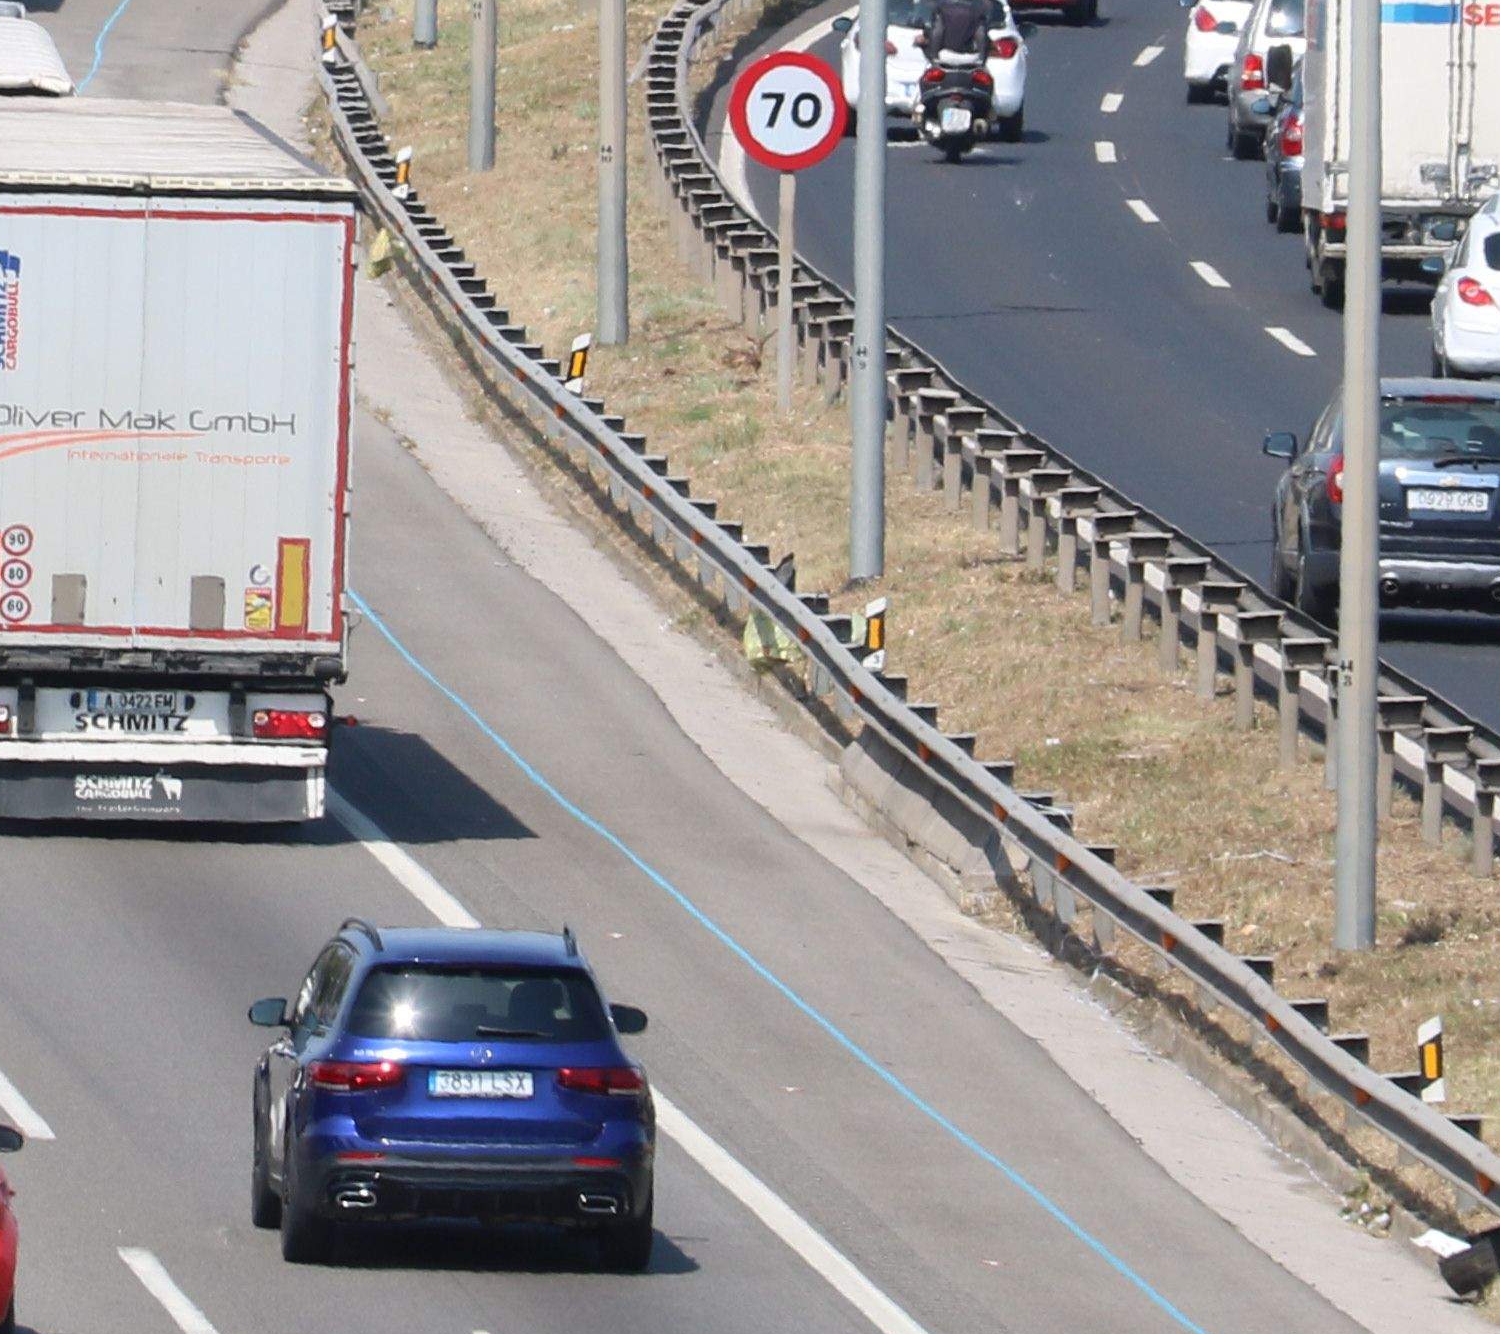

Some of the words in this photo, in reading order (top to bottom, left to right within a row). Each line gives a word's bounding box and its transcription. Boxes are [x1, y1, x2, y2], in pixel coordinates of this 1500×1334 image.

[758, 90, 823, 131] 70
[6, 280, 20, 371] CARGOBULL
[98, 408, 177, 432] Mak
[188, 409, 298, 436] GmbH
[67, 449, 189, 463] Internationale
[195, 451, 292, 466] Transporte
[8, 533, 26, 545] 90
[7, 568, 24, 580] 80
[7, 600, 24, 612] 60
[75, 713, 190, 732] SCHMITZ
[73, 774, 153, 790] SCHMITZ
[438, 1073, 484, 1091] 3831
[492, 1073, 526, 1092] LSX
